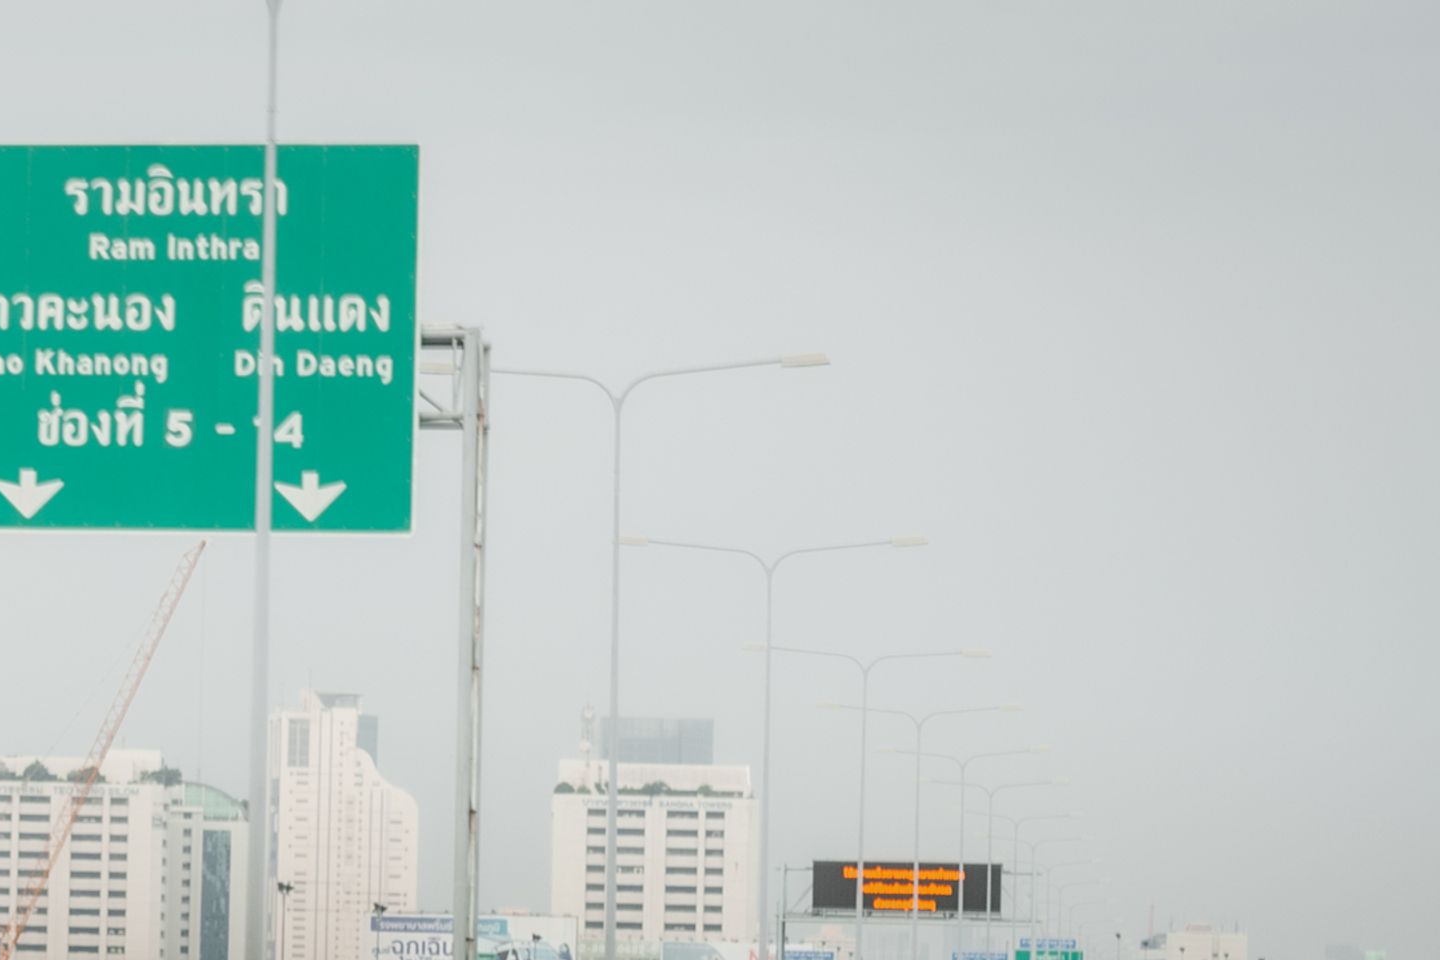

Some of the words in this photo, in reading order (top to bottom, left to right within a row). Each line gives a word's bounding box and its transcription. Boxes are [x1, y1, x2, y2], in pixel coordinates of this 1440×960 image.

[65, 164, 288, 216] รามอินทรา
[89, 234, 155, 260] Ram
[168, 234, 261, 260] Inthra
[242, 279, 390, 333] ดินแดง
[35, 349, 168, 384] Khanong
[296, 350, 393, 385] Daeng
[38, 381, 144, 447] ช่องที่
[165, 410, 193, 447] 5
[216, 422, 236, 435] -
[252, 411, 304, 449] 4
